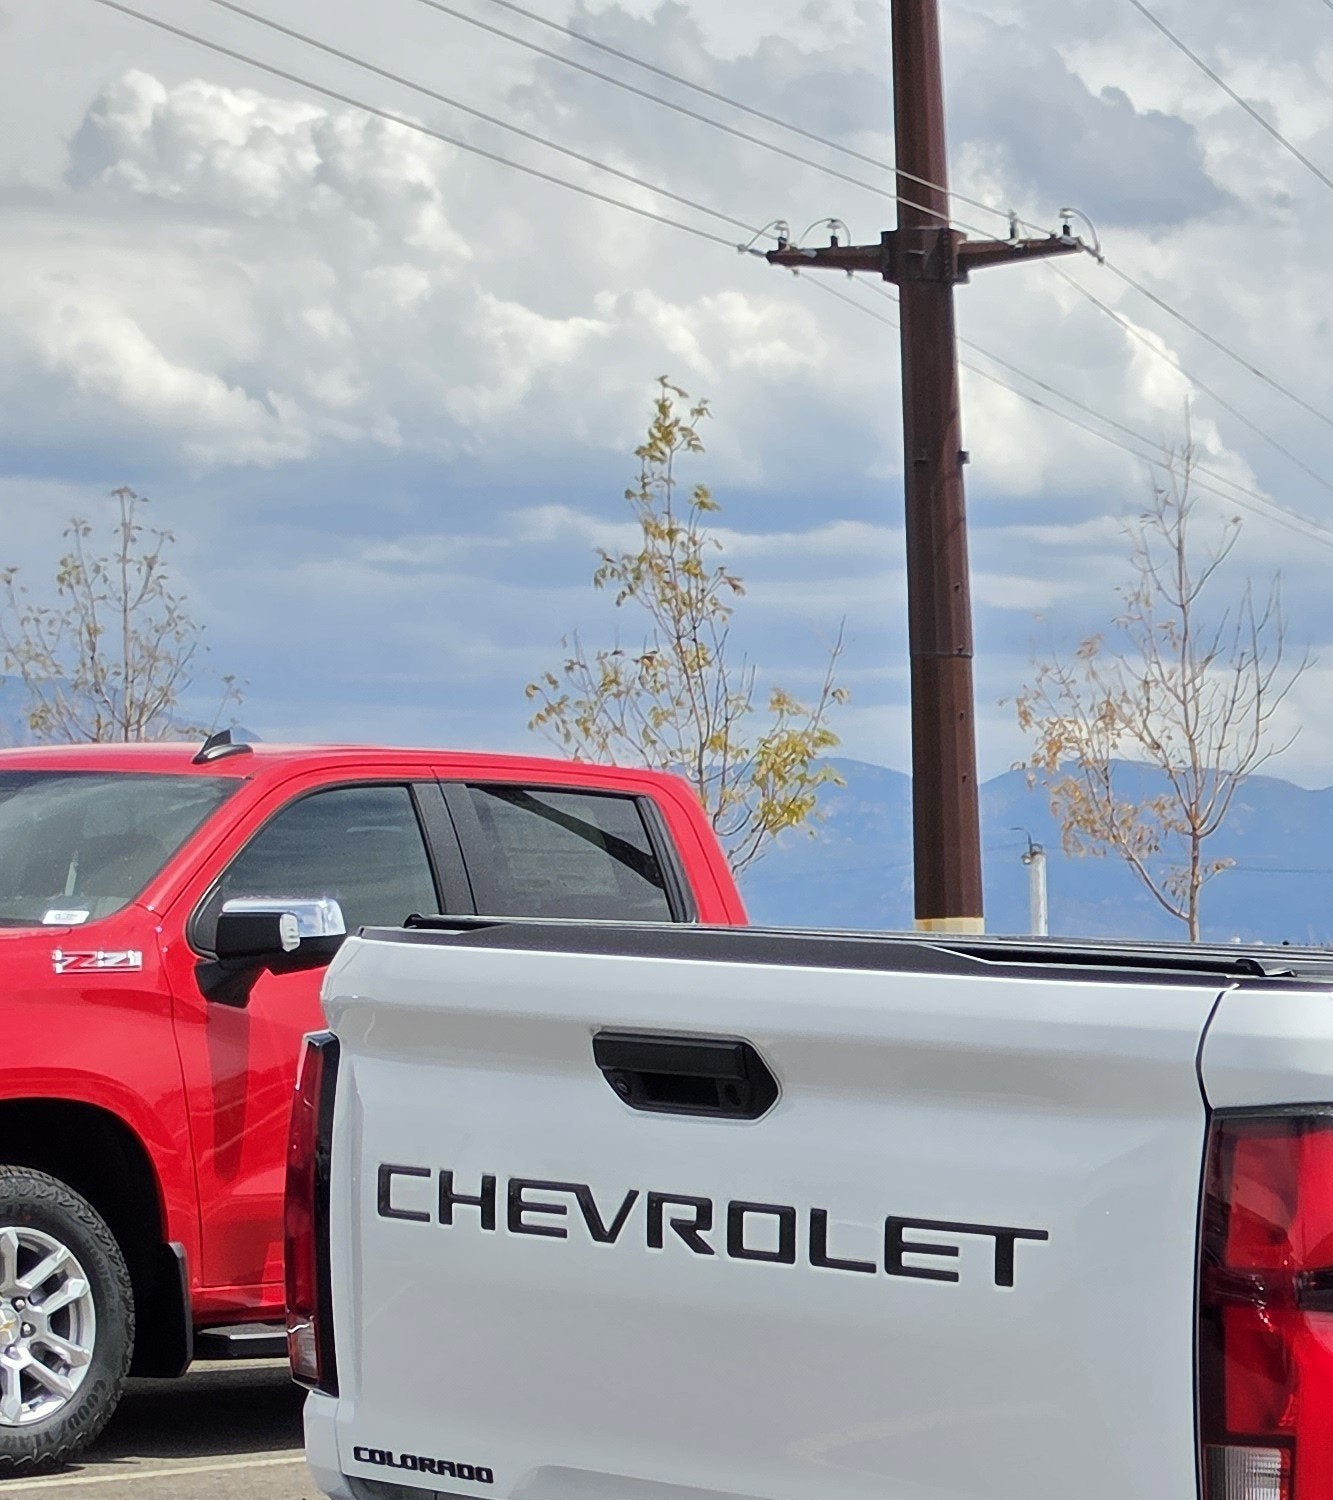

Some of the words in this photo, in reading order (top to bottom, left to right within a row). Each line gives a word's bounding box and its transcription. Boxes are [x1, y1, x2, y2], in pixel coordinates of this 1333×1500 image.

[52, 948, 142, 974] Z71
[377, 1163, 1049, 1288] CHEVROLET
[353, 1446, 494, 1484] COLORADO
